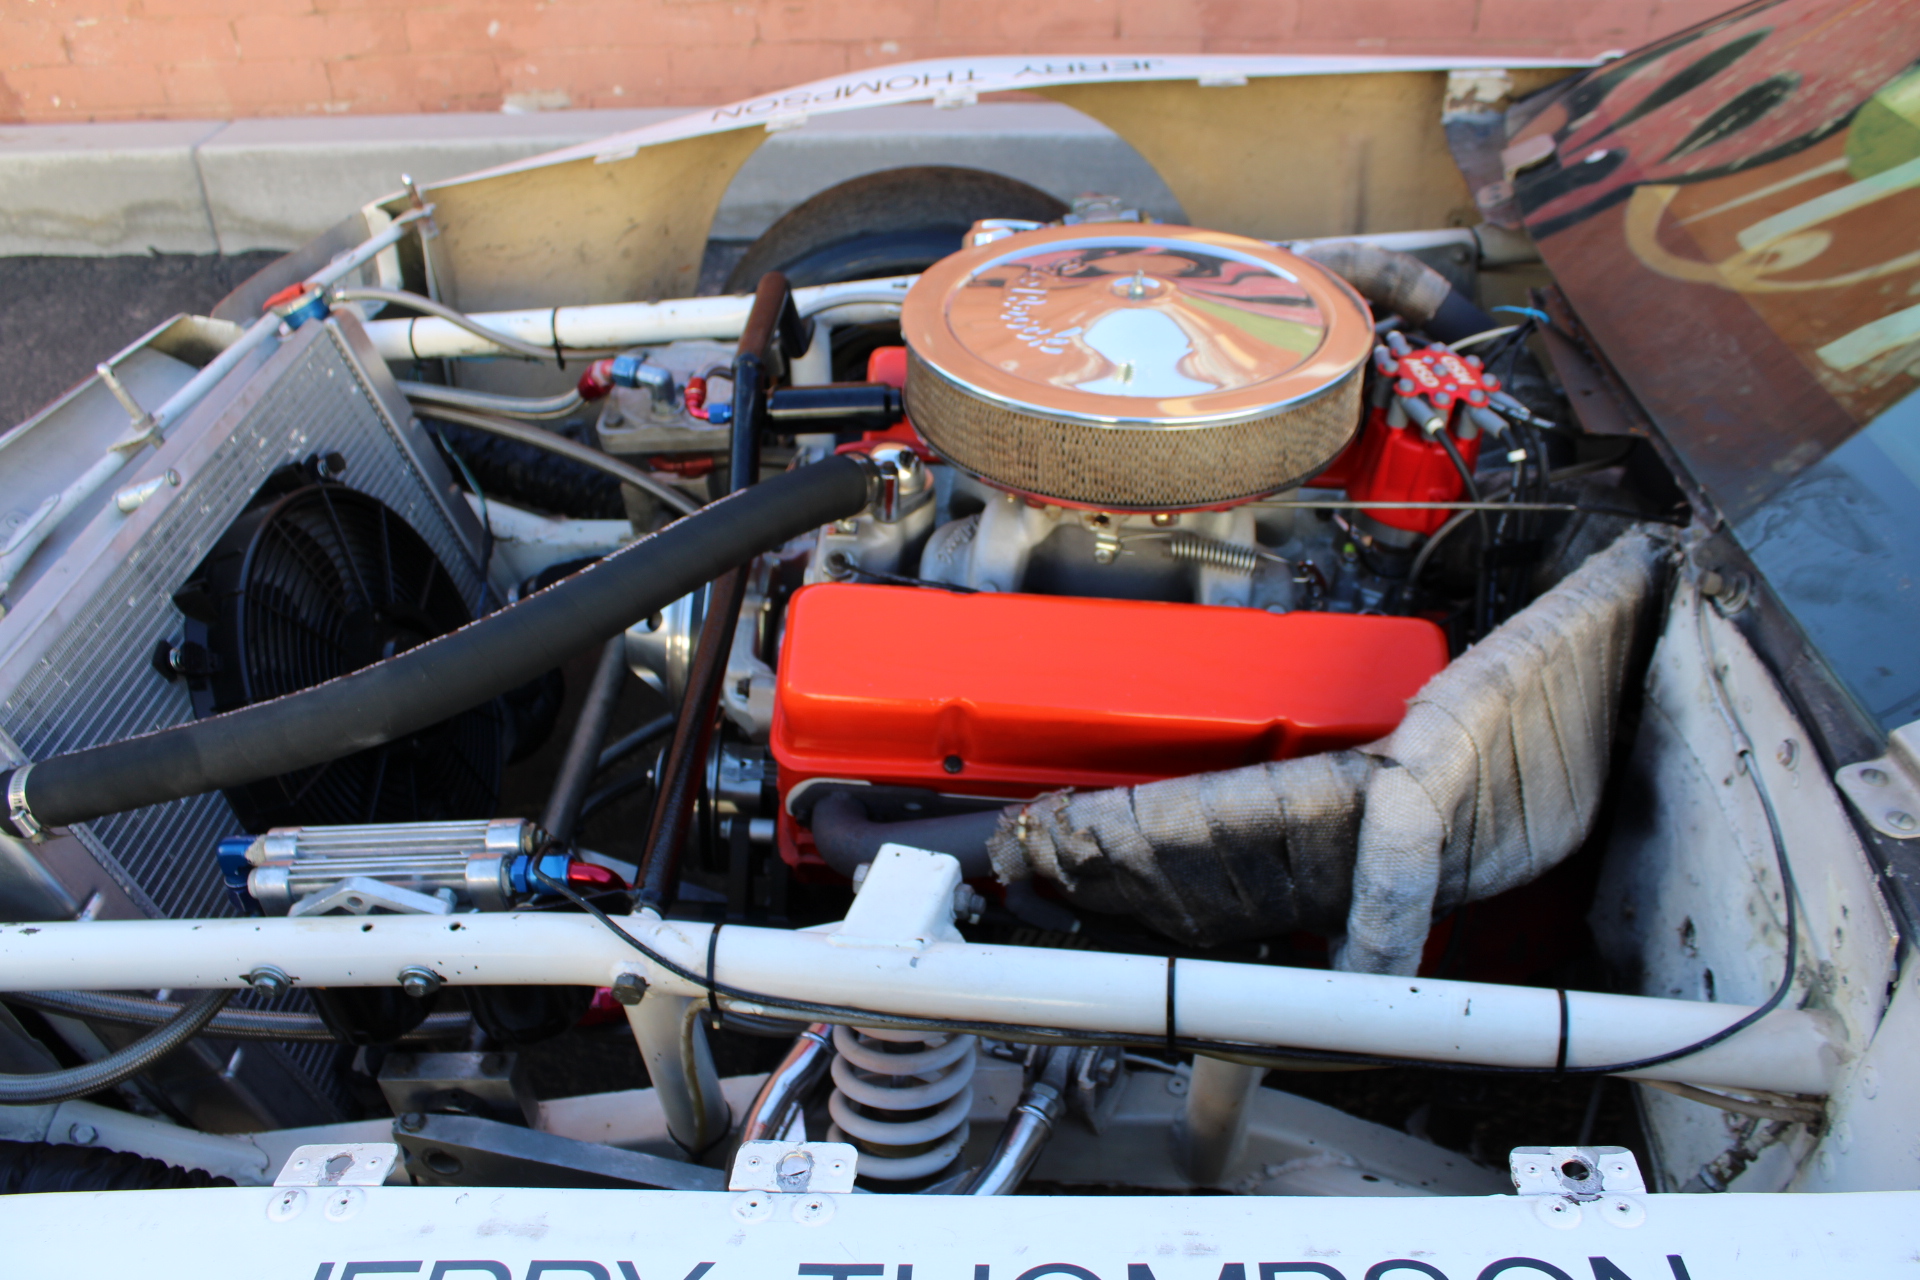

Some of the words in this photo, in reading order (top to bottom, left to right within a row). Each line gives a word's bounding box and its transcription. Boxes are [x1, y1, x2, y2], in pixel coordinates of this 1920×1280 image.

[1013, 59, 1163, 79] JERRY
[711, 68, 985, 123] THOMPSON
[1404, 358, 1440, 388] MSD
[1440, 355, 1477, 386] MSD
